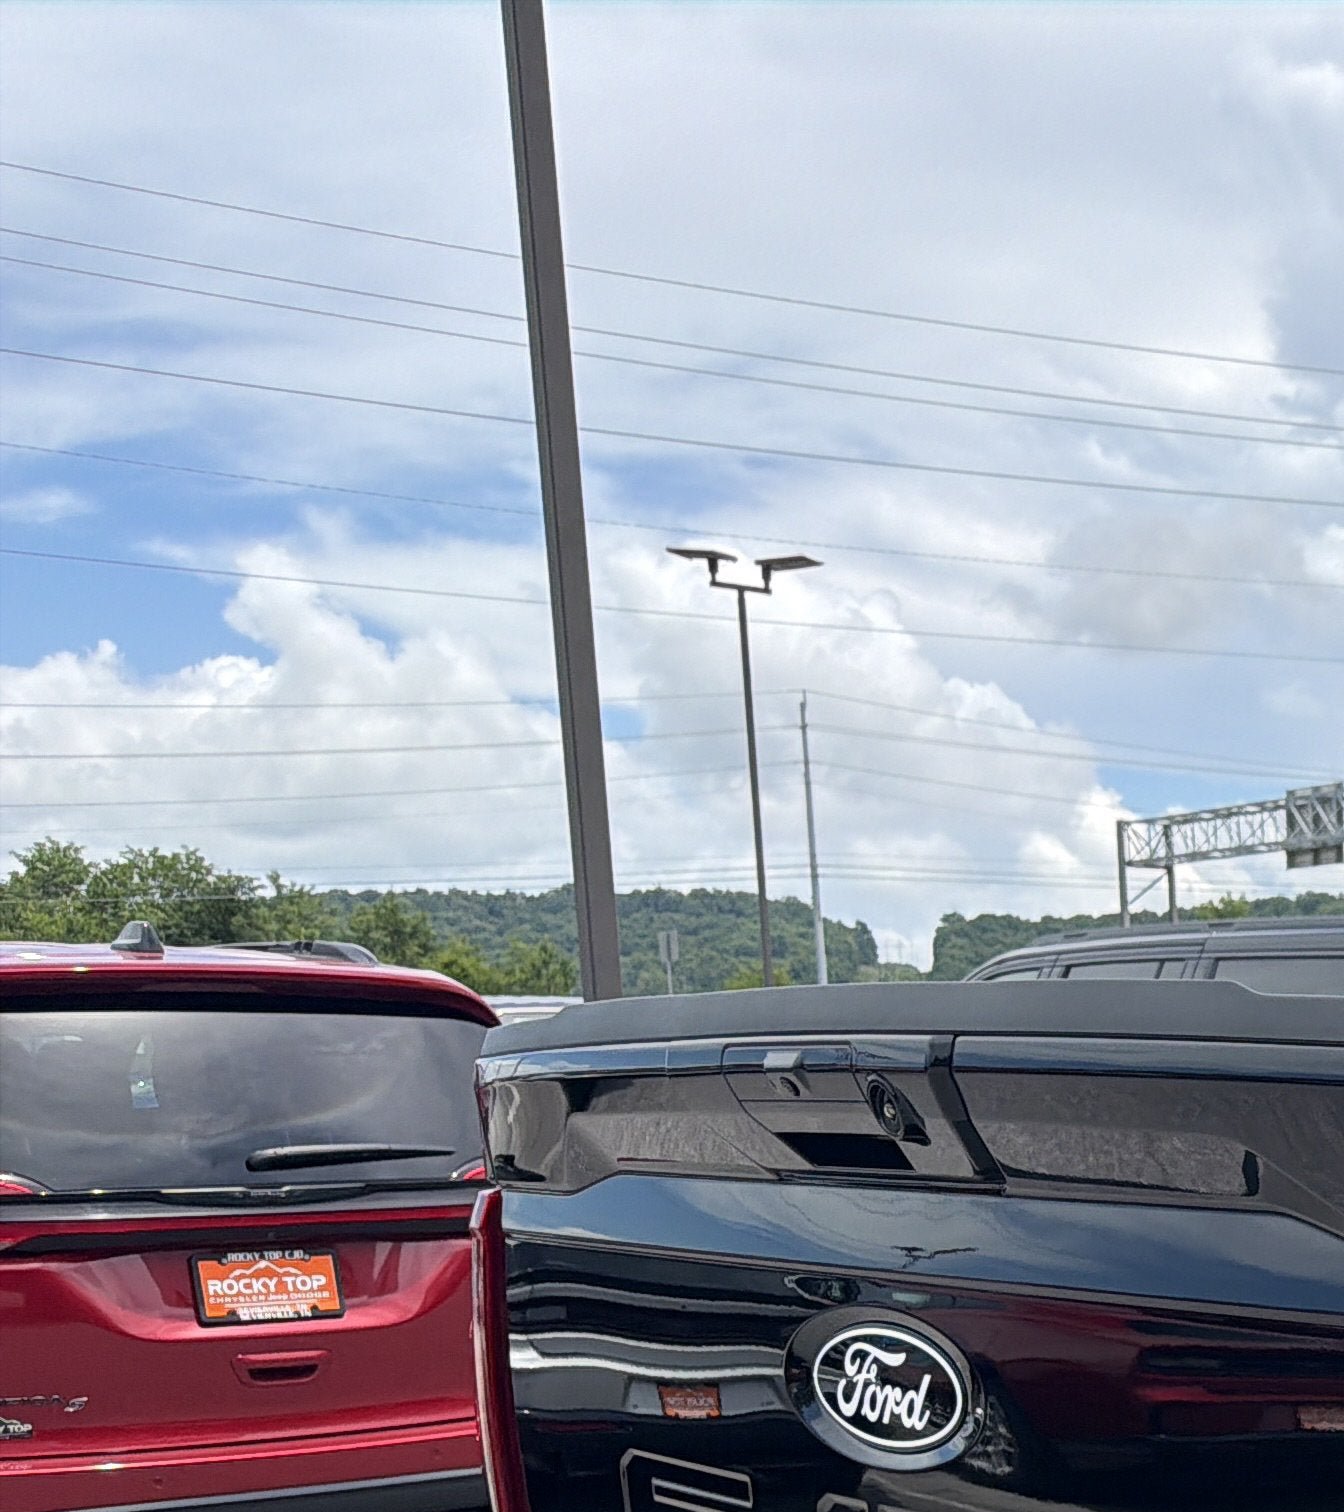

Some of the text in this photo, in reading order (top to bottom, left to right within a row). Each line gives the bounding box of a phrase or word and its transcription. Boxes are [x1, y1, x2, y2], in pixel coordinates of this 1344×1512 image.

[207, 1274, 327, 1296] ROCKY TOP
[837, 1343, 931, 1431] Ford
[7, 1424, 33, 1434] TOP
